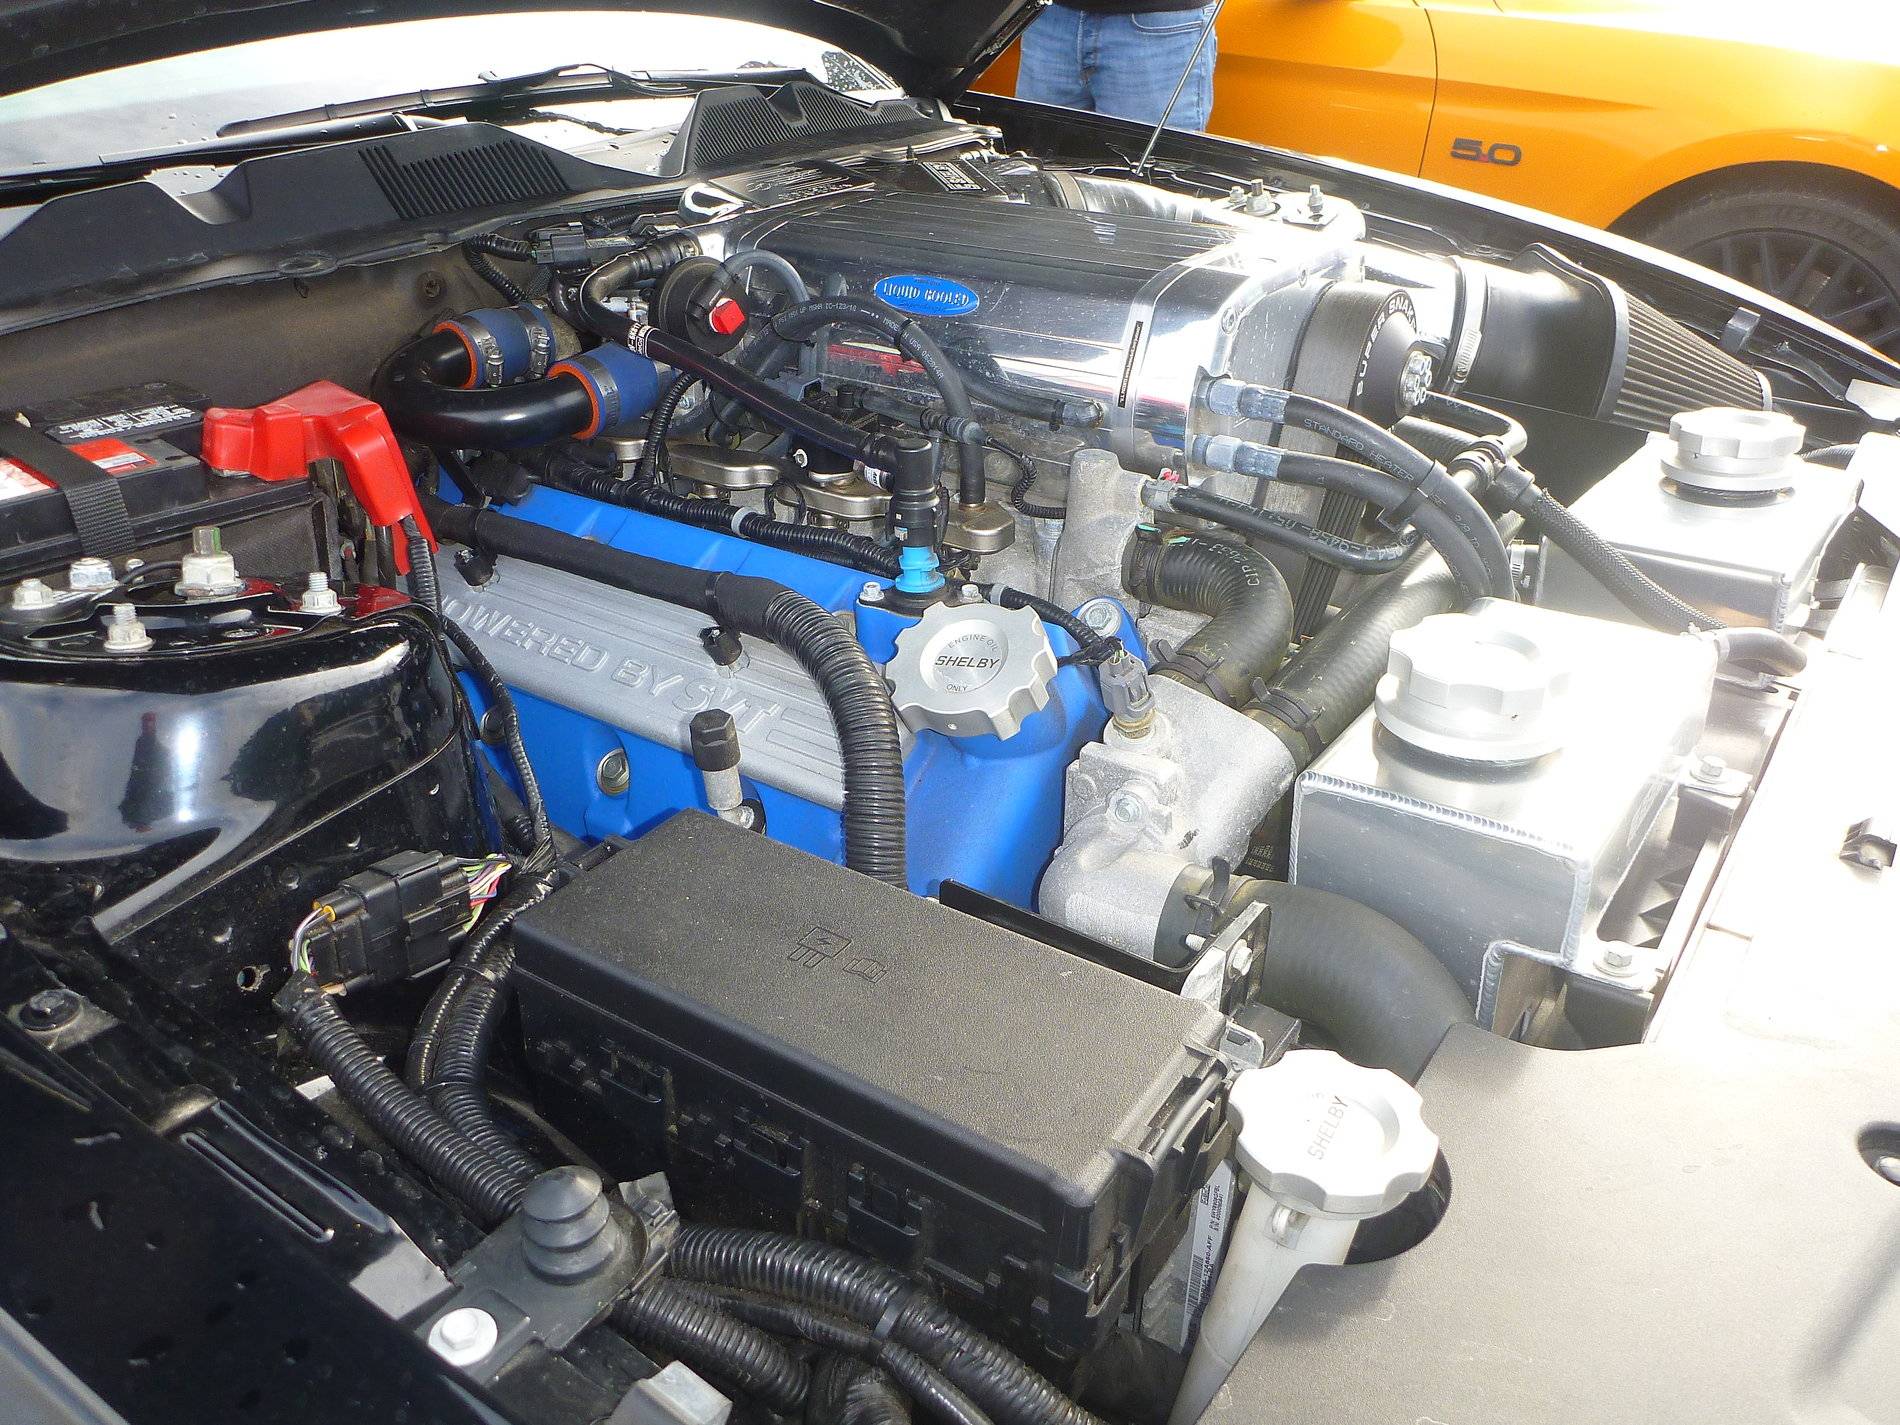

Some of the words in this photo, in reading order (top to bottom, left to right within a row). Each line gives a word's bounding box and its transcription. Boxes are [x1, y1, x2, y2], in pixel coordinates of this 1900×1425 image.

[1451, 137, 1522, 166] 5.0
[883, 282, 921, 299] LIQUID
[924, 288, 970, 306] COOLED
[882, 316, 900, 332] MADE
[1356, 311, 1386, 396] SUPER
[1303, 418, 1365, 451] STANDARD
[1369, 451, 1415, 482] HEATER
[442, 595, 608, 672] OWERED
[611, 656, 684, 696] BY
[947, 633, 987, 649] ENGINE
[986, 638, 999, 652] OIL
[934, 655, 1000, 669] SHELBY
[946, 683, 968, 692] ONLY
[1307, 1095, 1349, 1160] SHELBY
